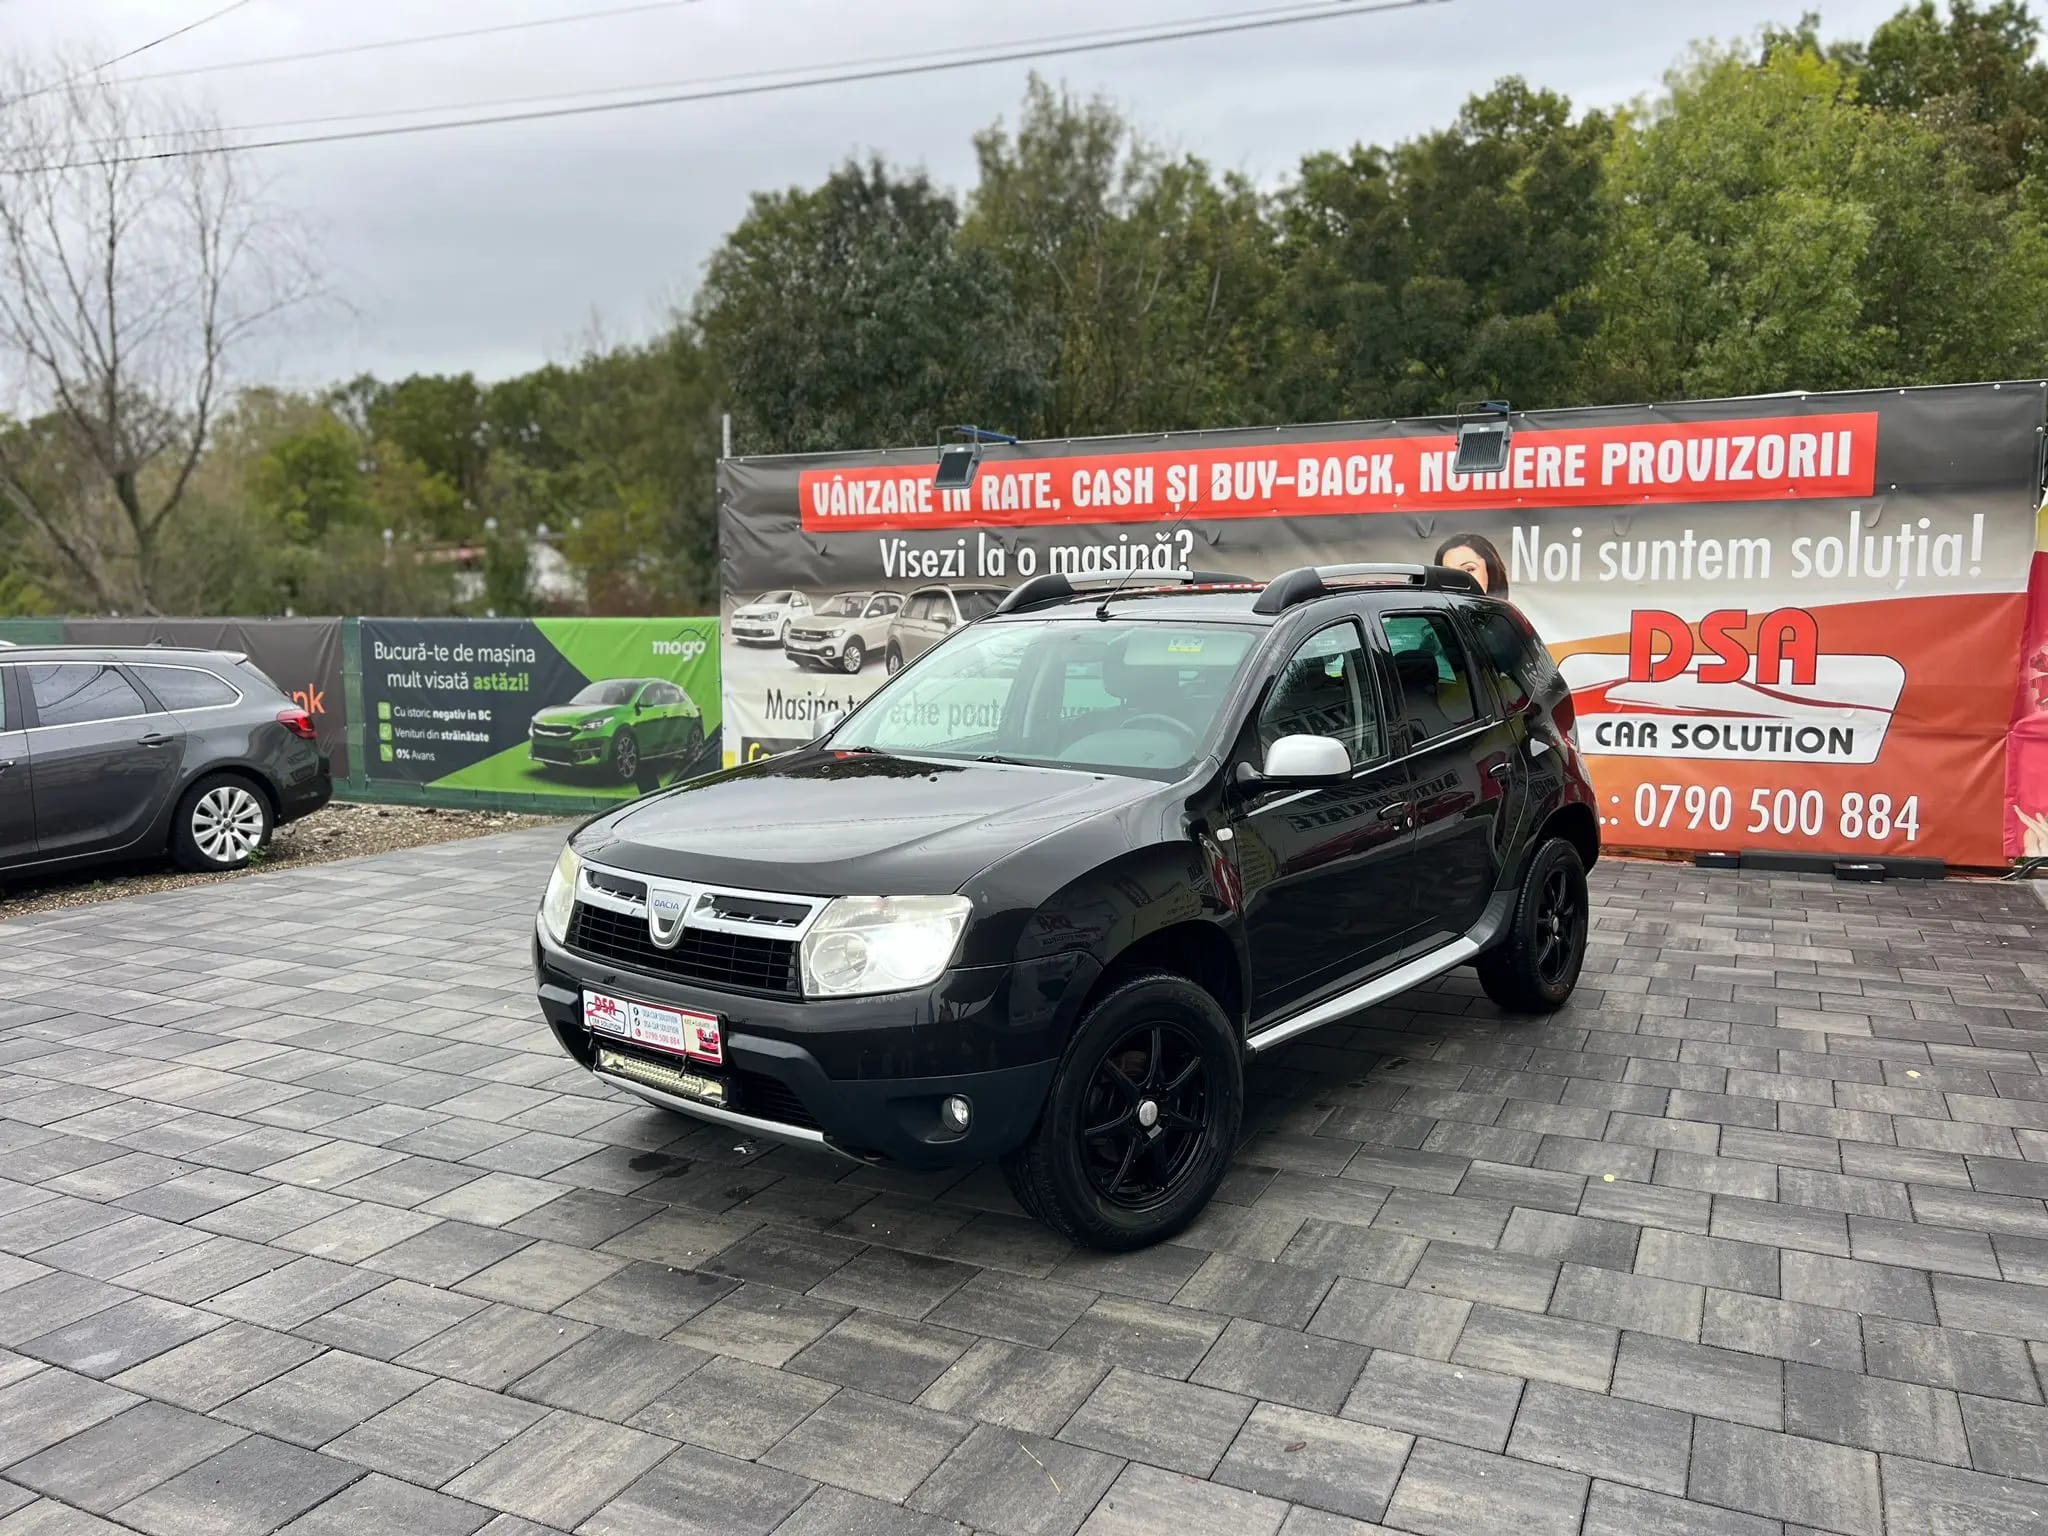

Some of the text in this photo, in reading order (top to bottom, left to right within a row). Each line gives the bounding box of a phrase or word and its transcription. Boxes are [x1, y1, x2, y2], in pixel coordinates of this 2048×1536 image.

[812, 475, 933, 516] VÂNZARE
[982, 472, 1061, 512] RATE,
[1072, 466, 1154, 507] CASH
[1166, 463, 1198, 512] ȘI
[1211, 453, 1405, 501] BUY-BACK,
[1601, 430, 1852, 486] PROVIZORII
[879, 538, 966, 578] Visezi
[978, 532, 1005, 577] la
[1017, 547, 1037, 577] o
[1511, 510, 1985, 590] Noi suntem soluția!
[374, 641, 536, 668] Bucură-te de mașina
[652, 640, 706, 662] mogo
[1628, 607, 1819, 685] DSA
[387, 670, 529, 691] mult visată astăzi!
[393, 706, 406, 717] Cu
[407, 706, 432, 719] istoric
[432, 708, 466, 722] negativ
[478, 709, 492, 721] BC
[394, 727, 425, 739] Venituri
[426, 727, 440, 740] din
[1595, 722, 1854, 755] CAR SOLUTION
[396, 748, 436, 761] 0% Avans
[1634, 782, 1732, 832] 0790
[1746, 788, 1824, 836] 500
[1838, 791, 1920, 841] 884
[654, 899, 680, 910] DACIA
[594, 995, 617, 1017] DSA
